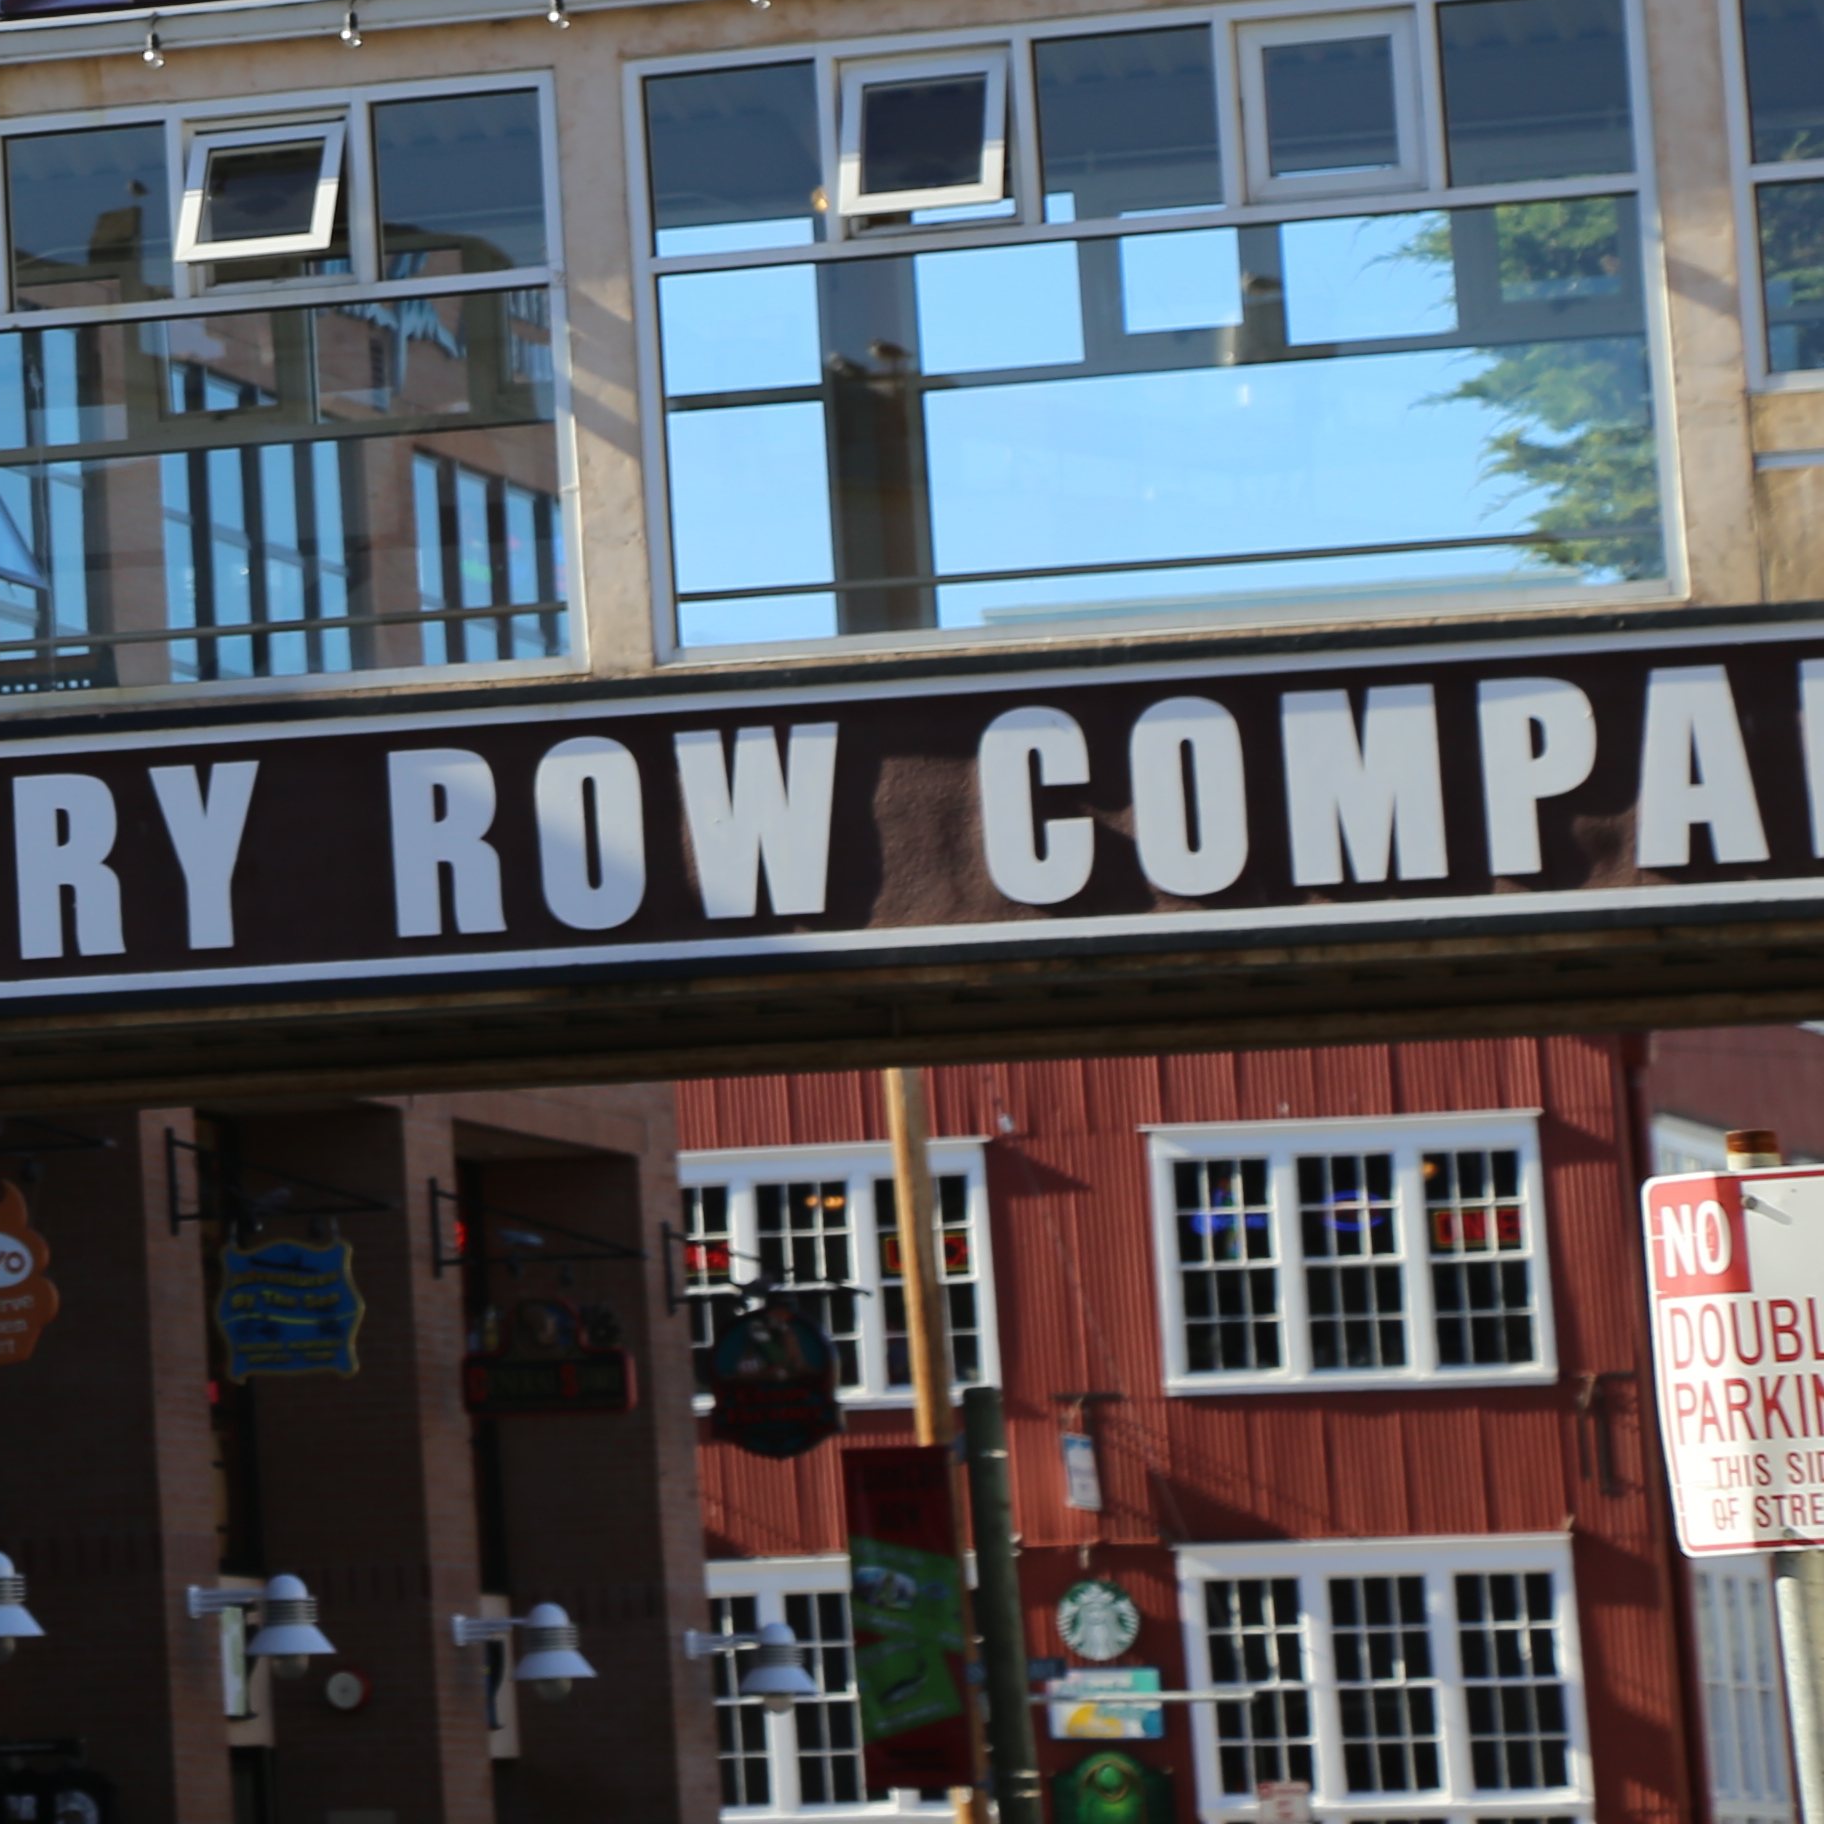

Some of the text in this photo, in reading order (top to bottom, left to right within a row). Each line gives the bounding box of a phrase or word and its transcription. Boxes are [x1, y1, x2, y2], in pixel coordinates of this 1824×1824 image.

[387, 721, 839, 933] ROW
[977, 659, 1824, 906] COMPA
[1661, 1200, 1732, 1278] NO
[1711, 1454, 1771, 1489] THIS
[1714, 1493, 1824, 1530] OF STRE
